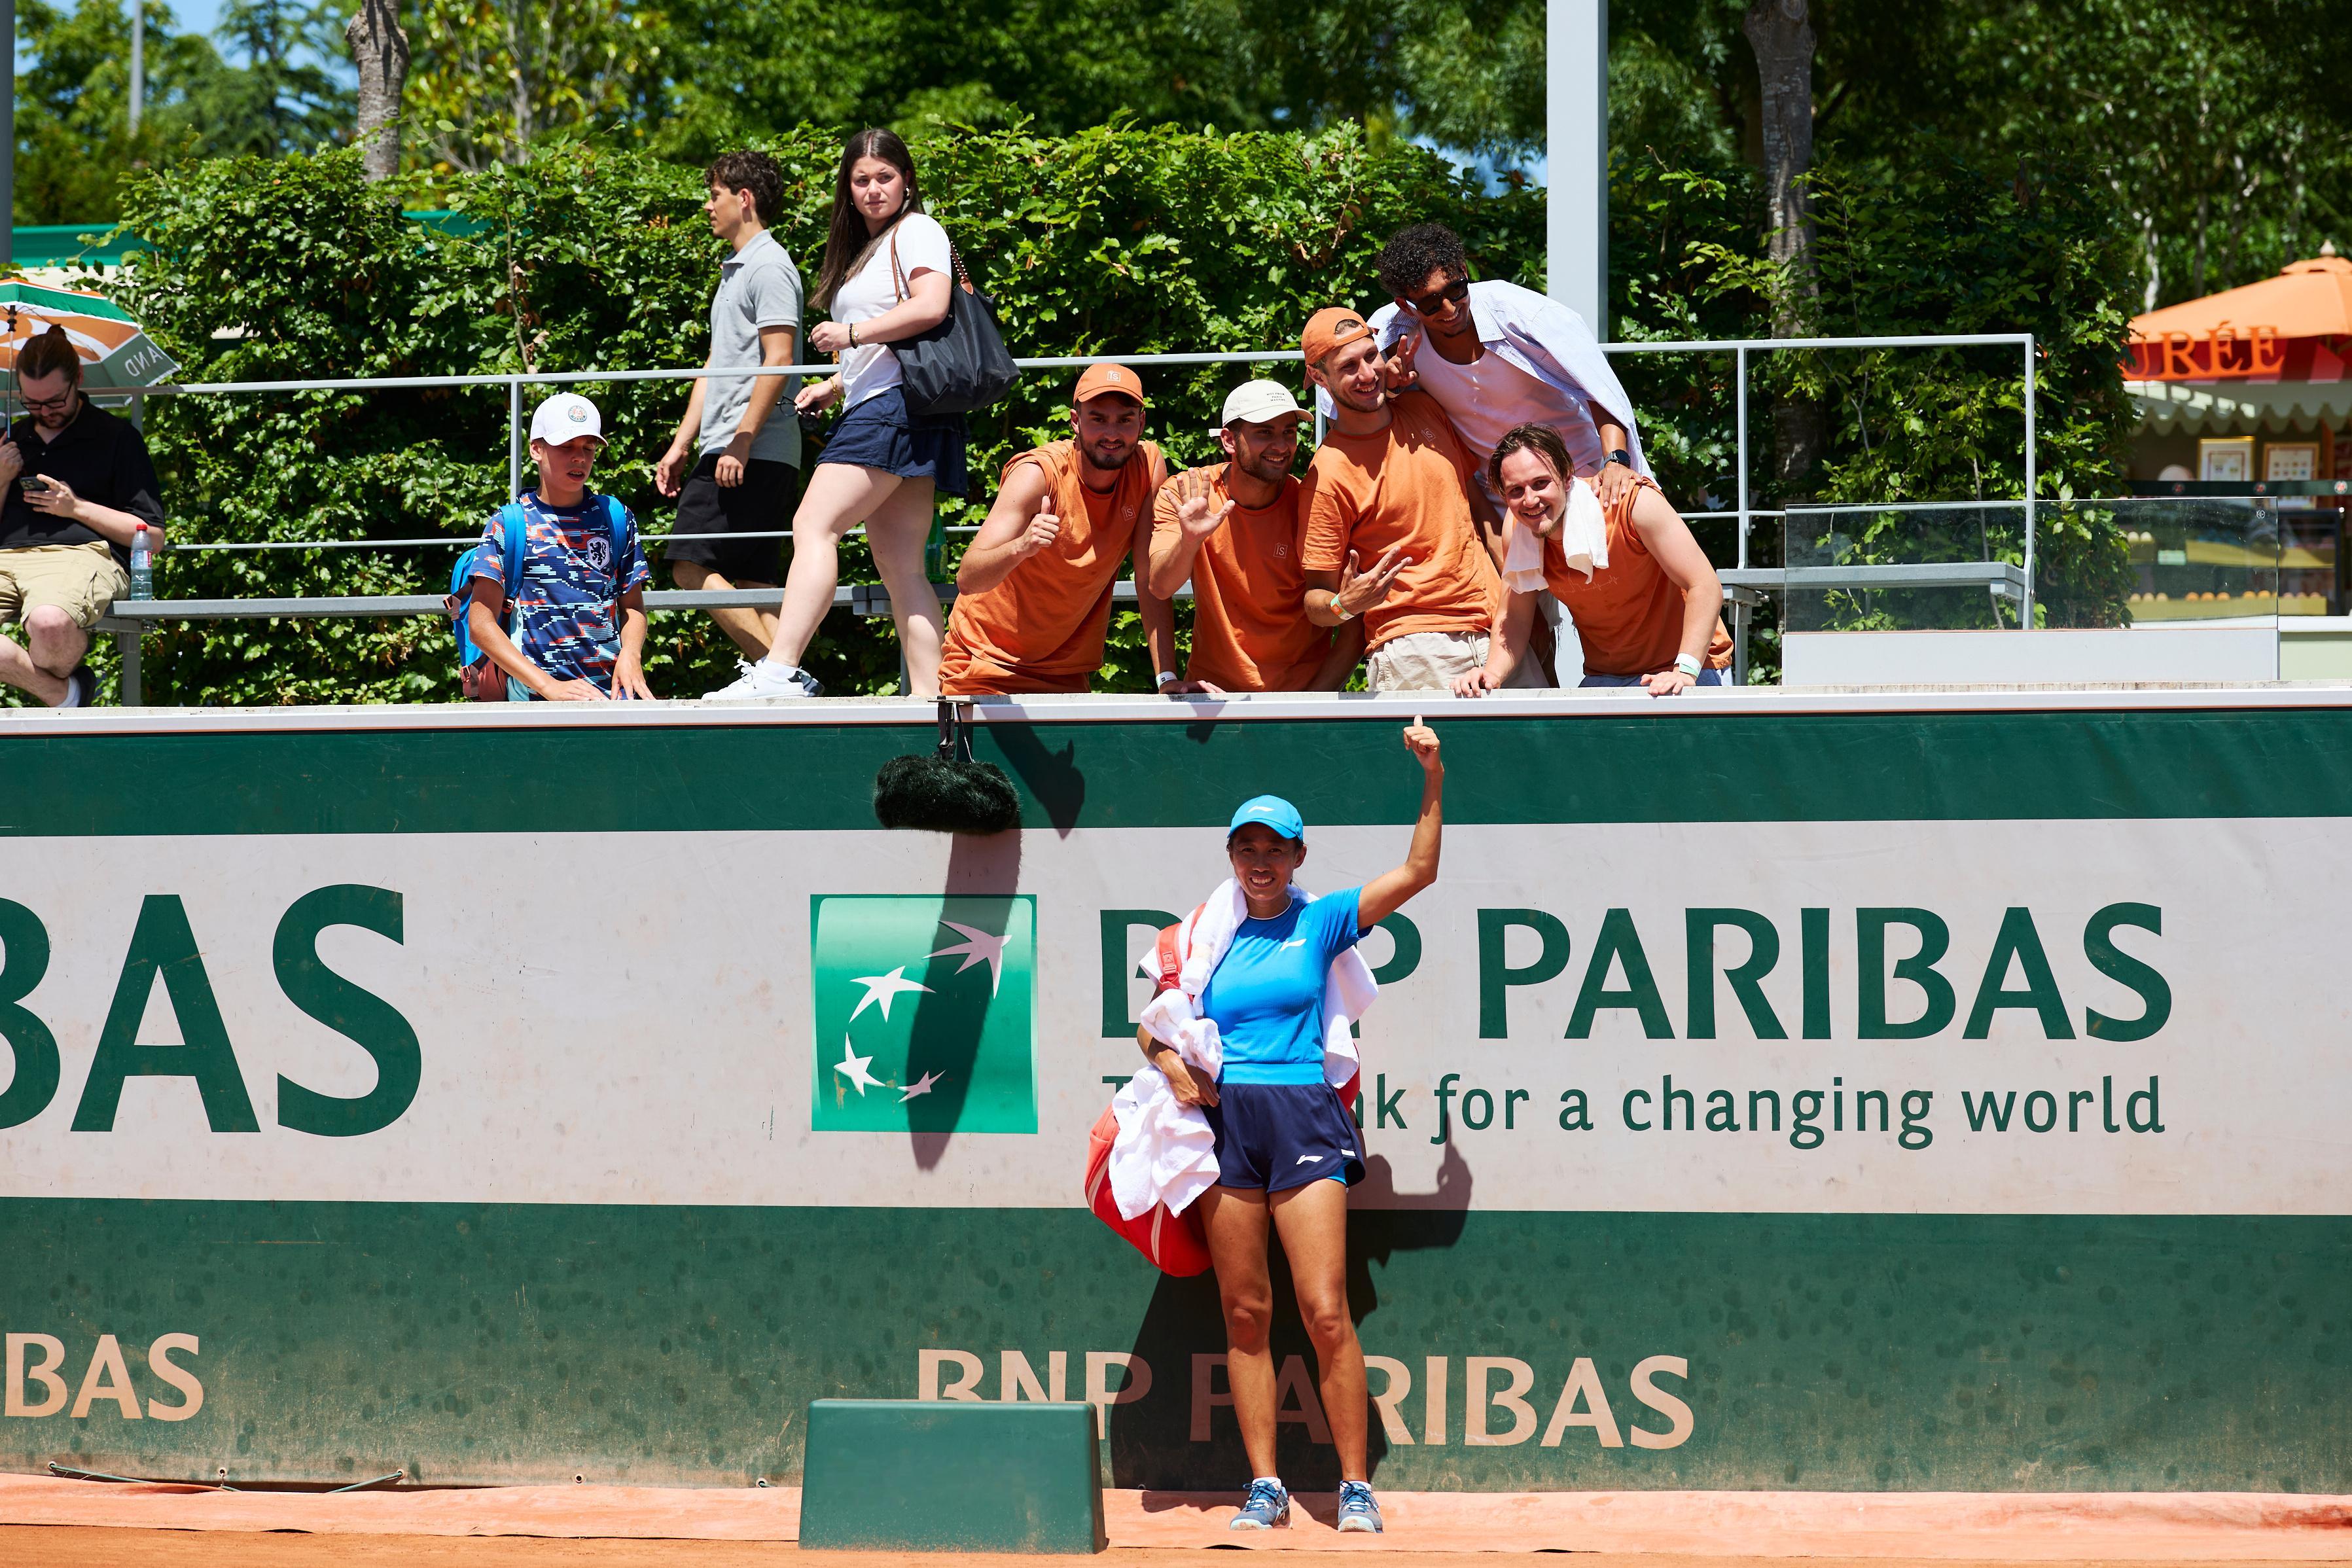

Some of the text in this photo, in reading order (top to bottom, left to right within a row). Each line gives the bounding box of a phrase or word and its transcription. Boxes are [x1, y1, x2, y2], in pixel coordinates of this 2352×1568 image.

[1478, 902, 2171, 1042] PARIBAS
[1431, 1074, 1529, 1145] for
[1559, 1089, 1594, 1131] a
[1623, 1075, 1933, 1150] changing
[1961, 1075, 2165, 1133] world
[5, 1332, 204, 1421] BAS
